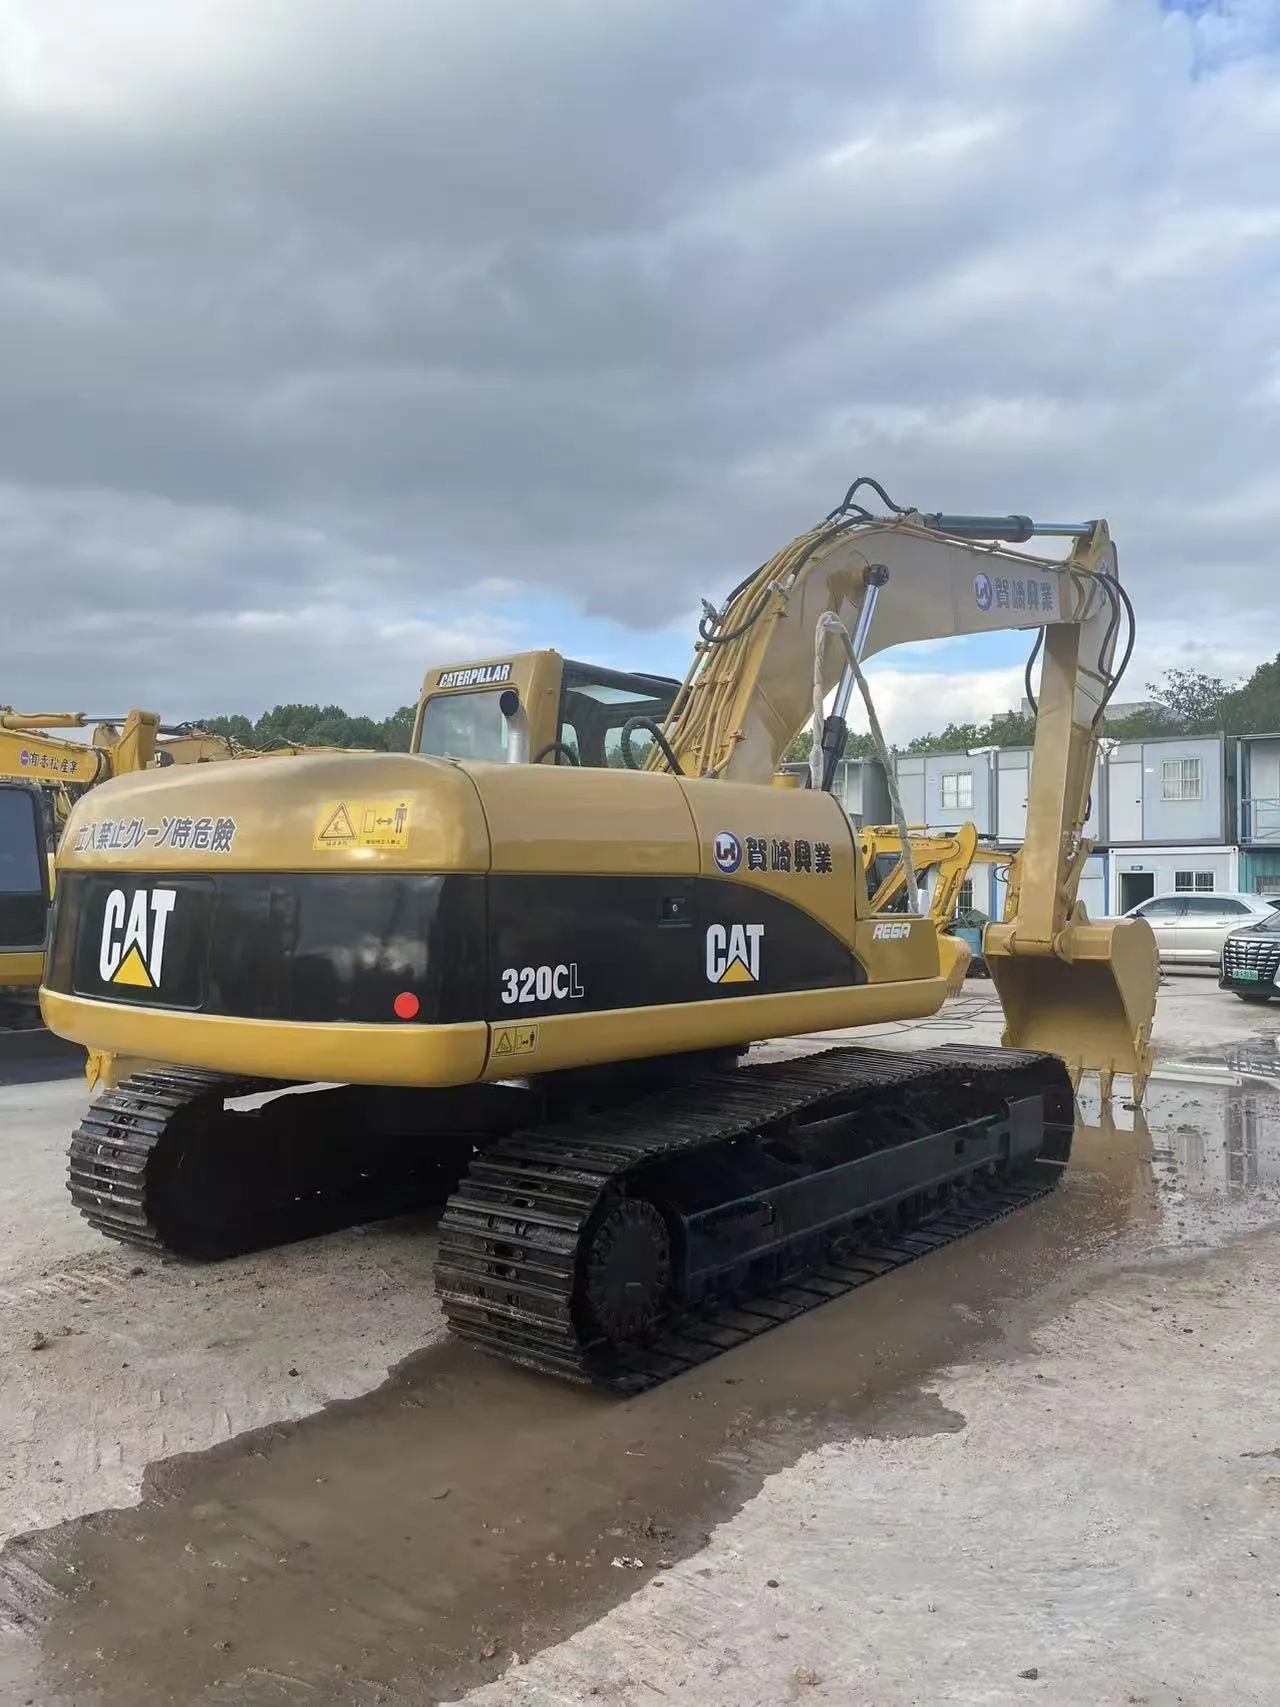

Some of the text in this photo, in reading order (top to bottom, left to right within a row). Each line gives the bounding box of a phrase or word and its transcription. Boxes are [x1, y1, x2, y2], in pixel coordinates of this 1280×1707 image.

[439, 664, 510, 687] CATERPILLAR
[100, 889, 177, 988] CAT
[706, 923, 765, 984] CAT
[501, 963, 585, 1004] 320CL
